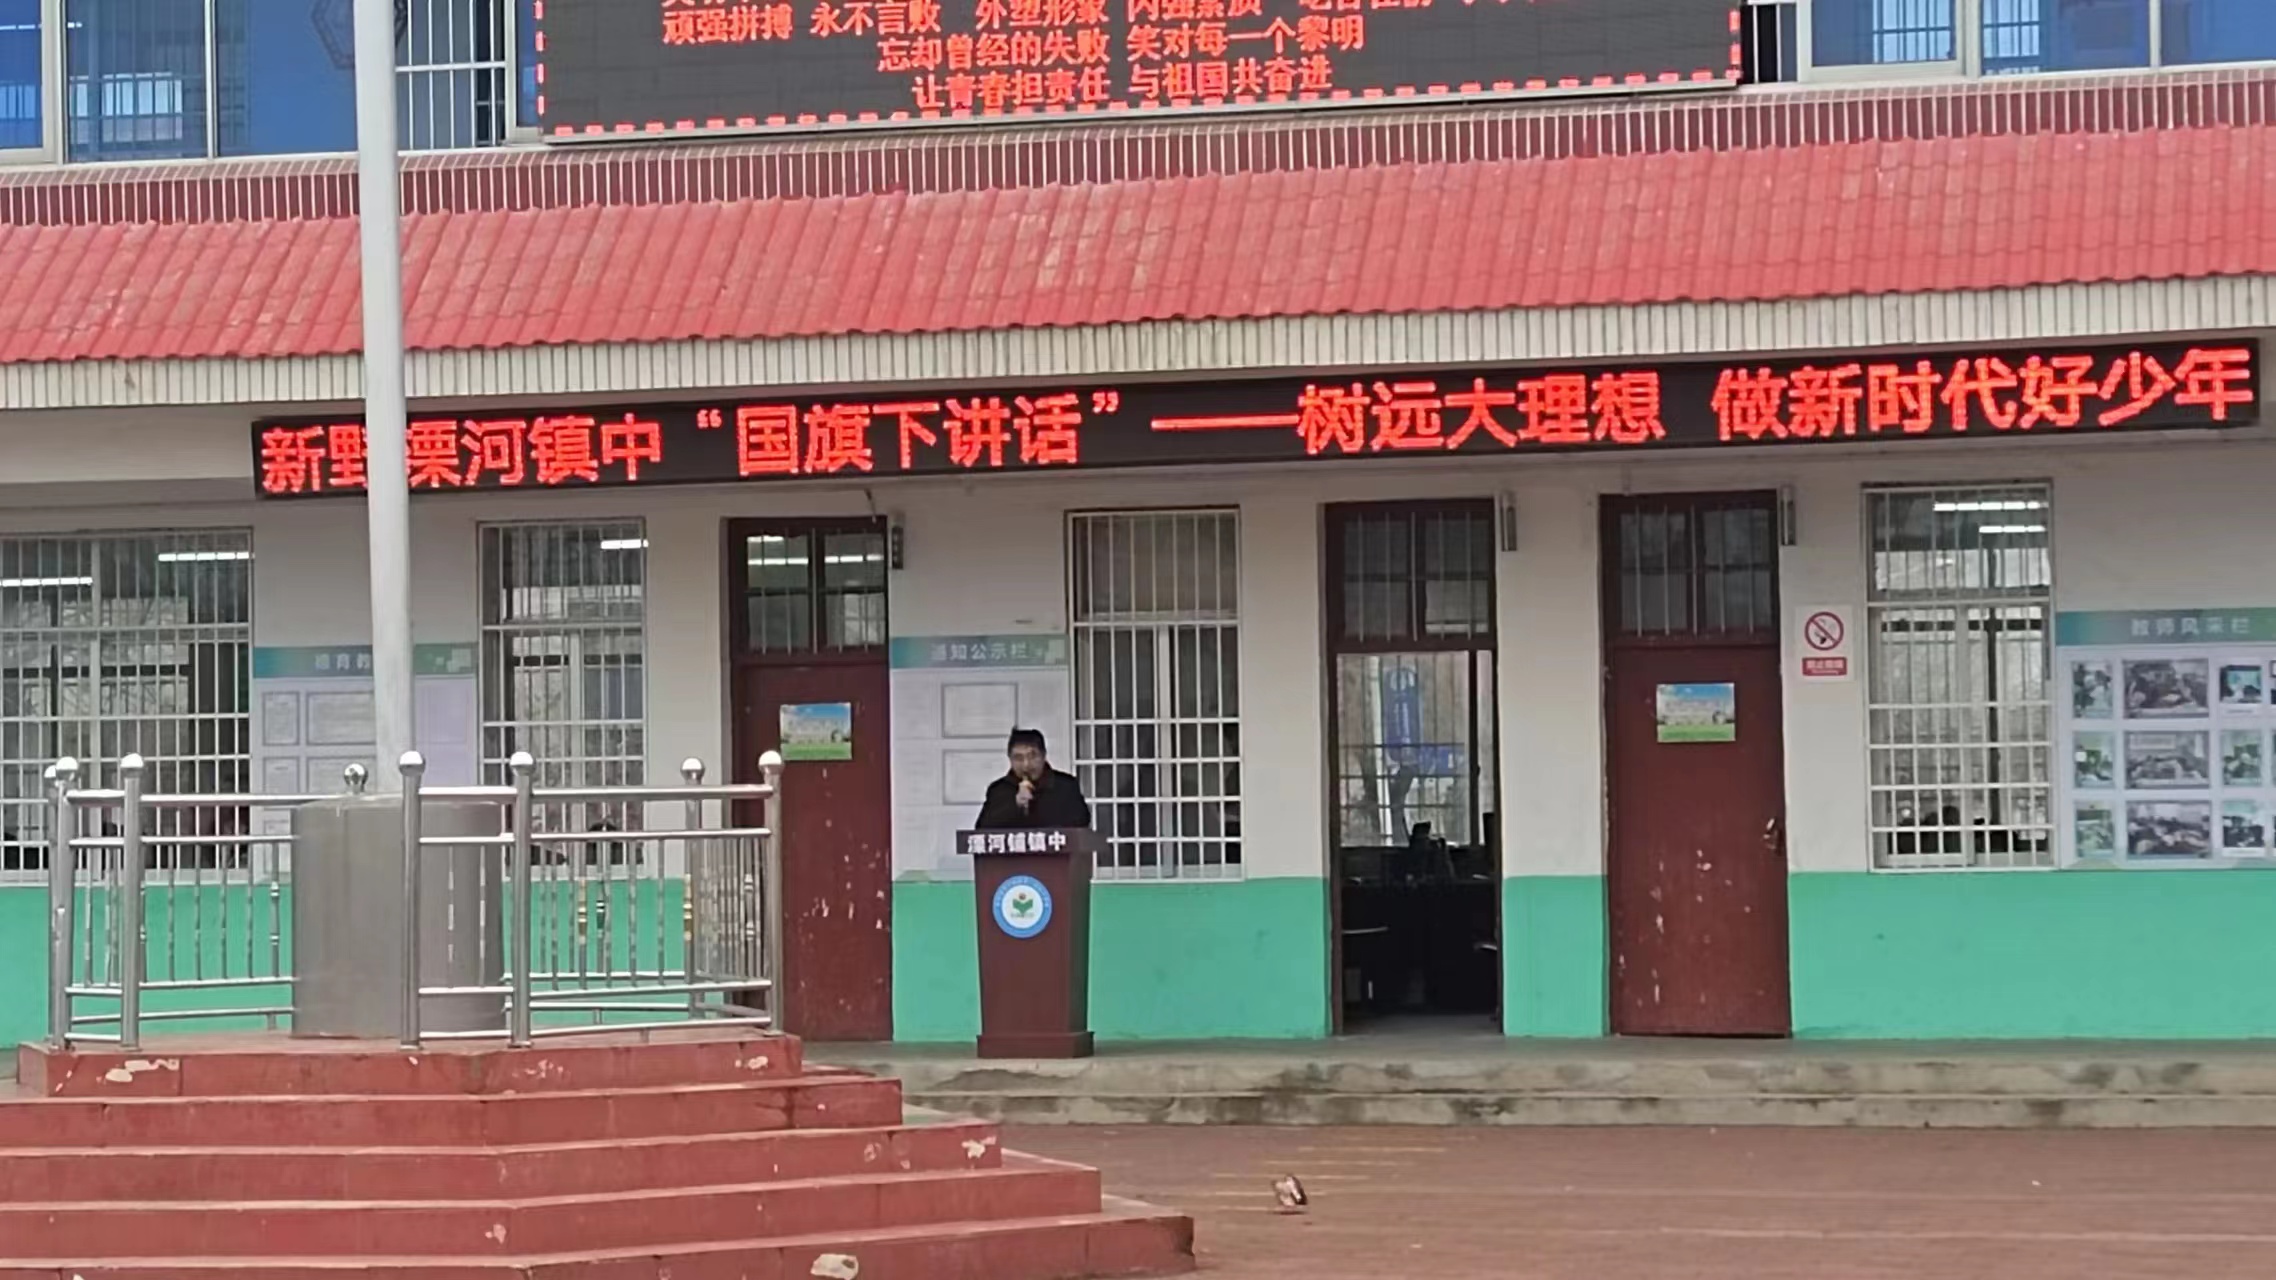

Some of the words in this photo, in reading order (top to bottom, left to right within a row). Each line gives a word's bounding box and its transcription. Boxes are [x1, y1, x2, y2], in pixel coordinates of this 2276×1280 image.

[662, 3, 793, 45] 顽强拼搏
[811, 0, 942, 37] 永不言败
[876, 27, 1111, 72] 忘却曾经的失败
[1126, 15, 1365, 62] 笑对每一个黎明
[912, 66, 1111, 110] 让青春担责任
[1128, 54, 1333, 99] 与祖国共奋进
[1710, 347, 2255, 443] 做新时代好少年
